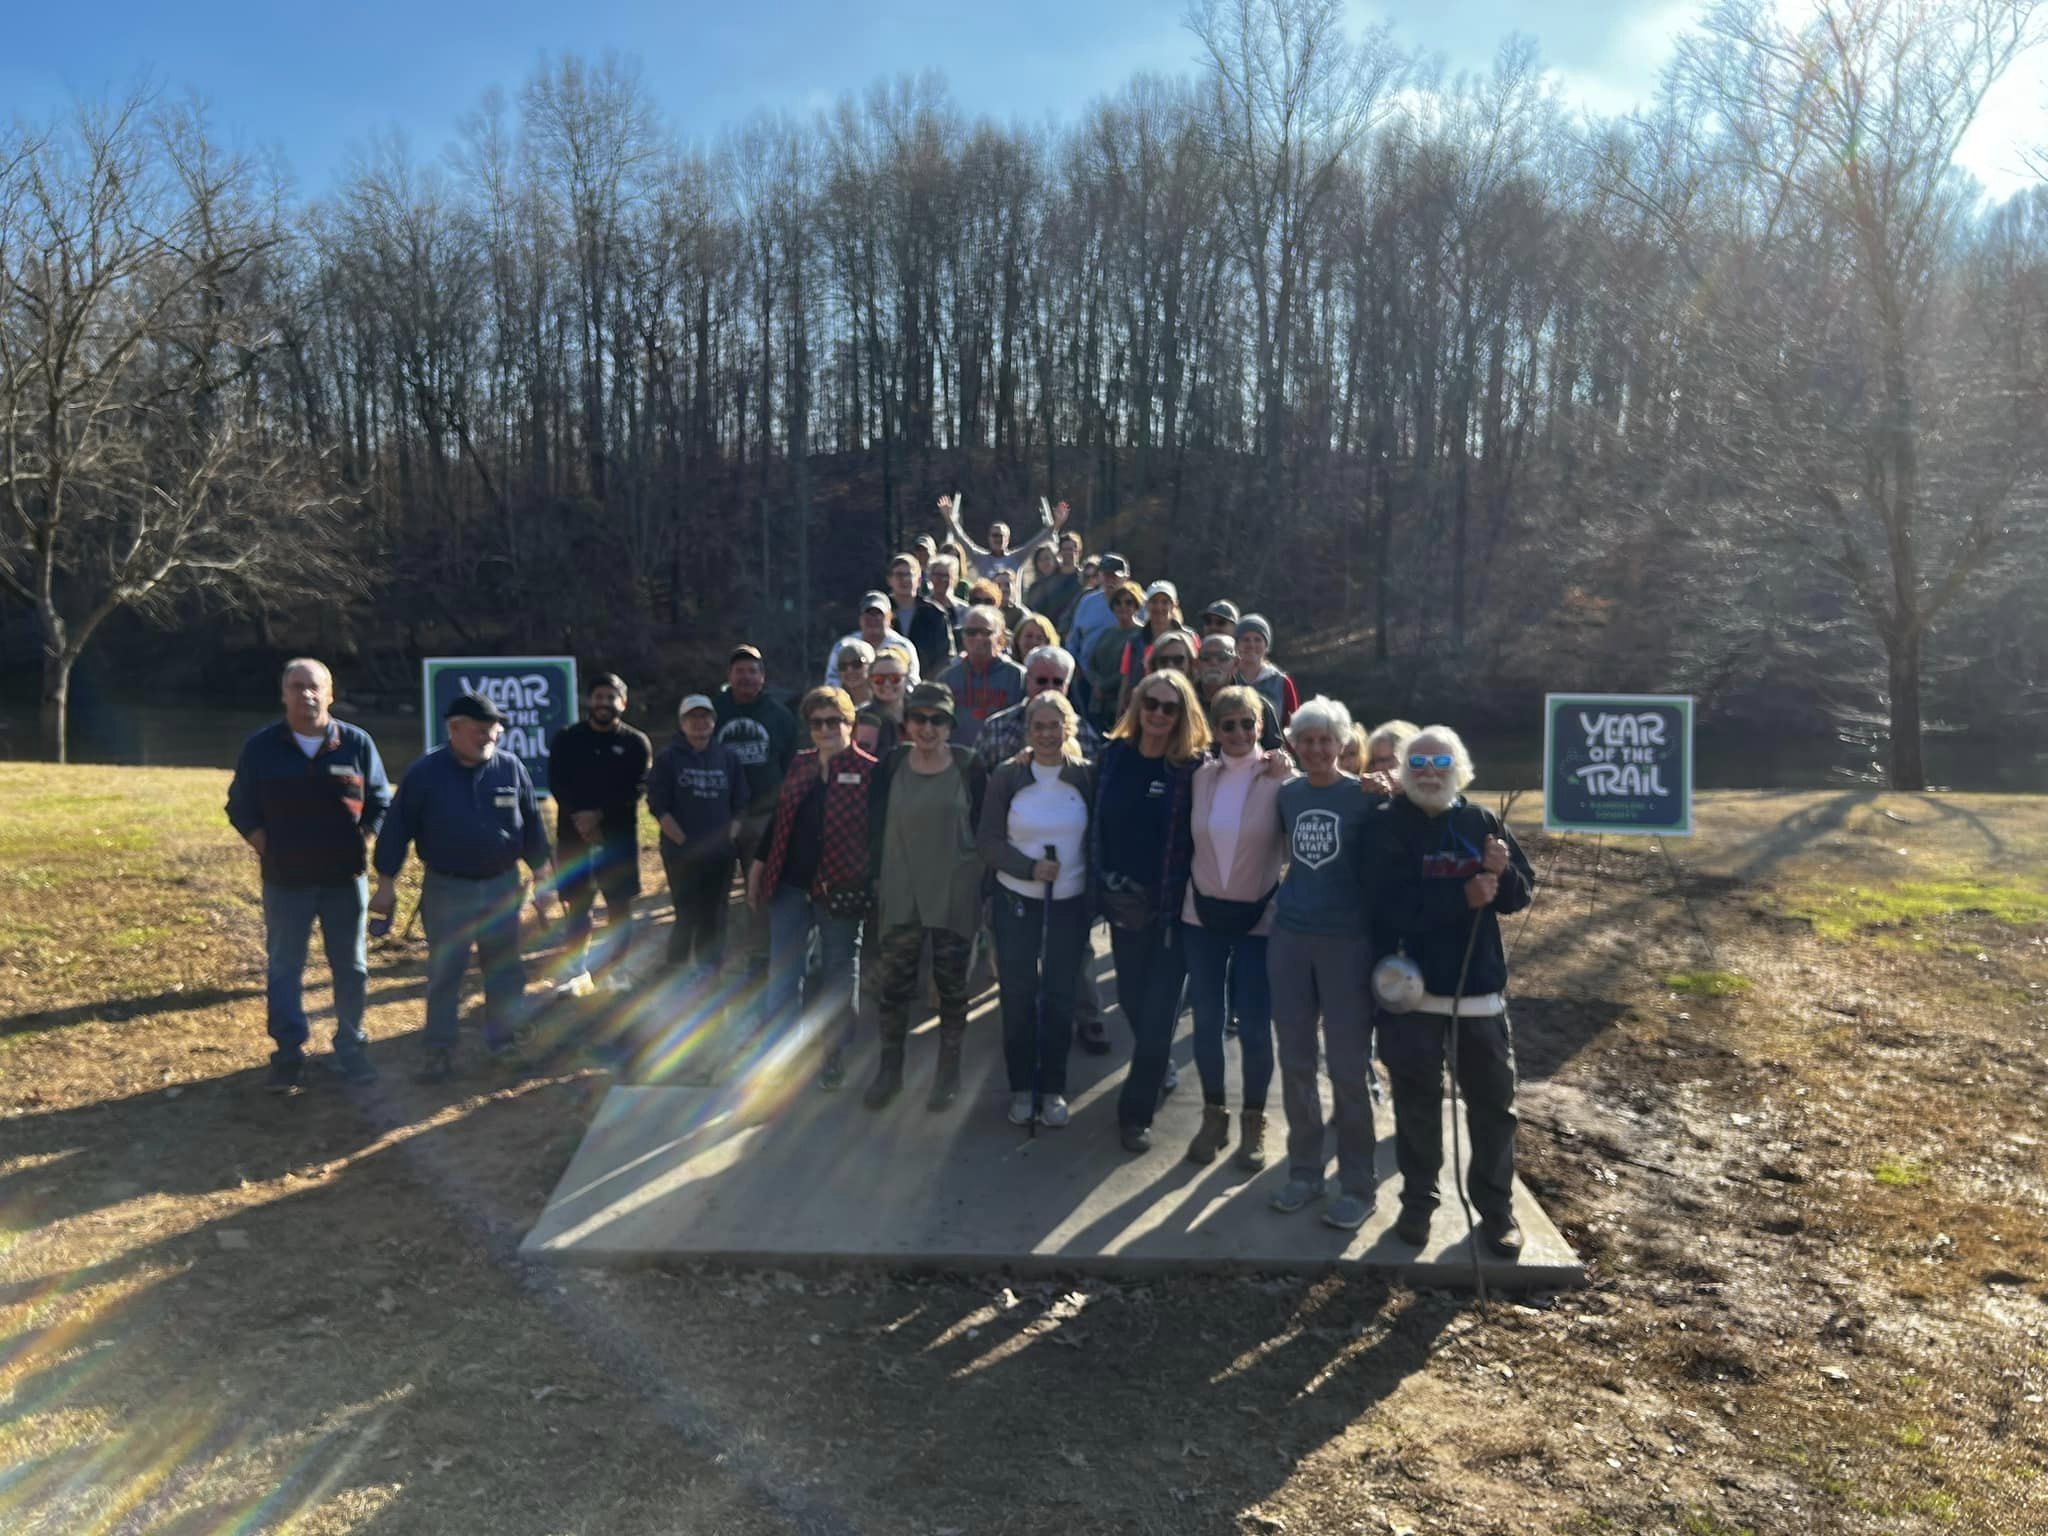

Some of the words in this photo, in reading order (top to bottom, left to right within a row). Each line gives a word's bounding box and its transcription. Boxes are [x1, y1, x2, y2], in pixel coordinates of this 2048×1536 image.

[459, 674, 550, 709] YEAR
[507, 709, 540, 726] THE
[1579, 712, 1666, 747] YEAR
[1589, 747, 1615, 763] OF
[1621, 747, 1654, 763] THE
[1576, 763, 1669, 797] TRAIL
[1299, 822, 1331, 832] GREAT
[1297, 832, 1333, 841] TRAILS
[1299, 841, 1330, 852] STATE
